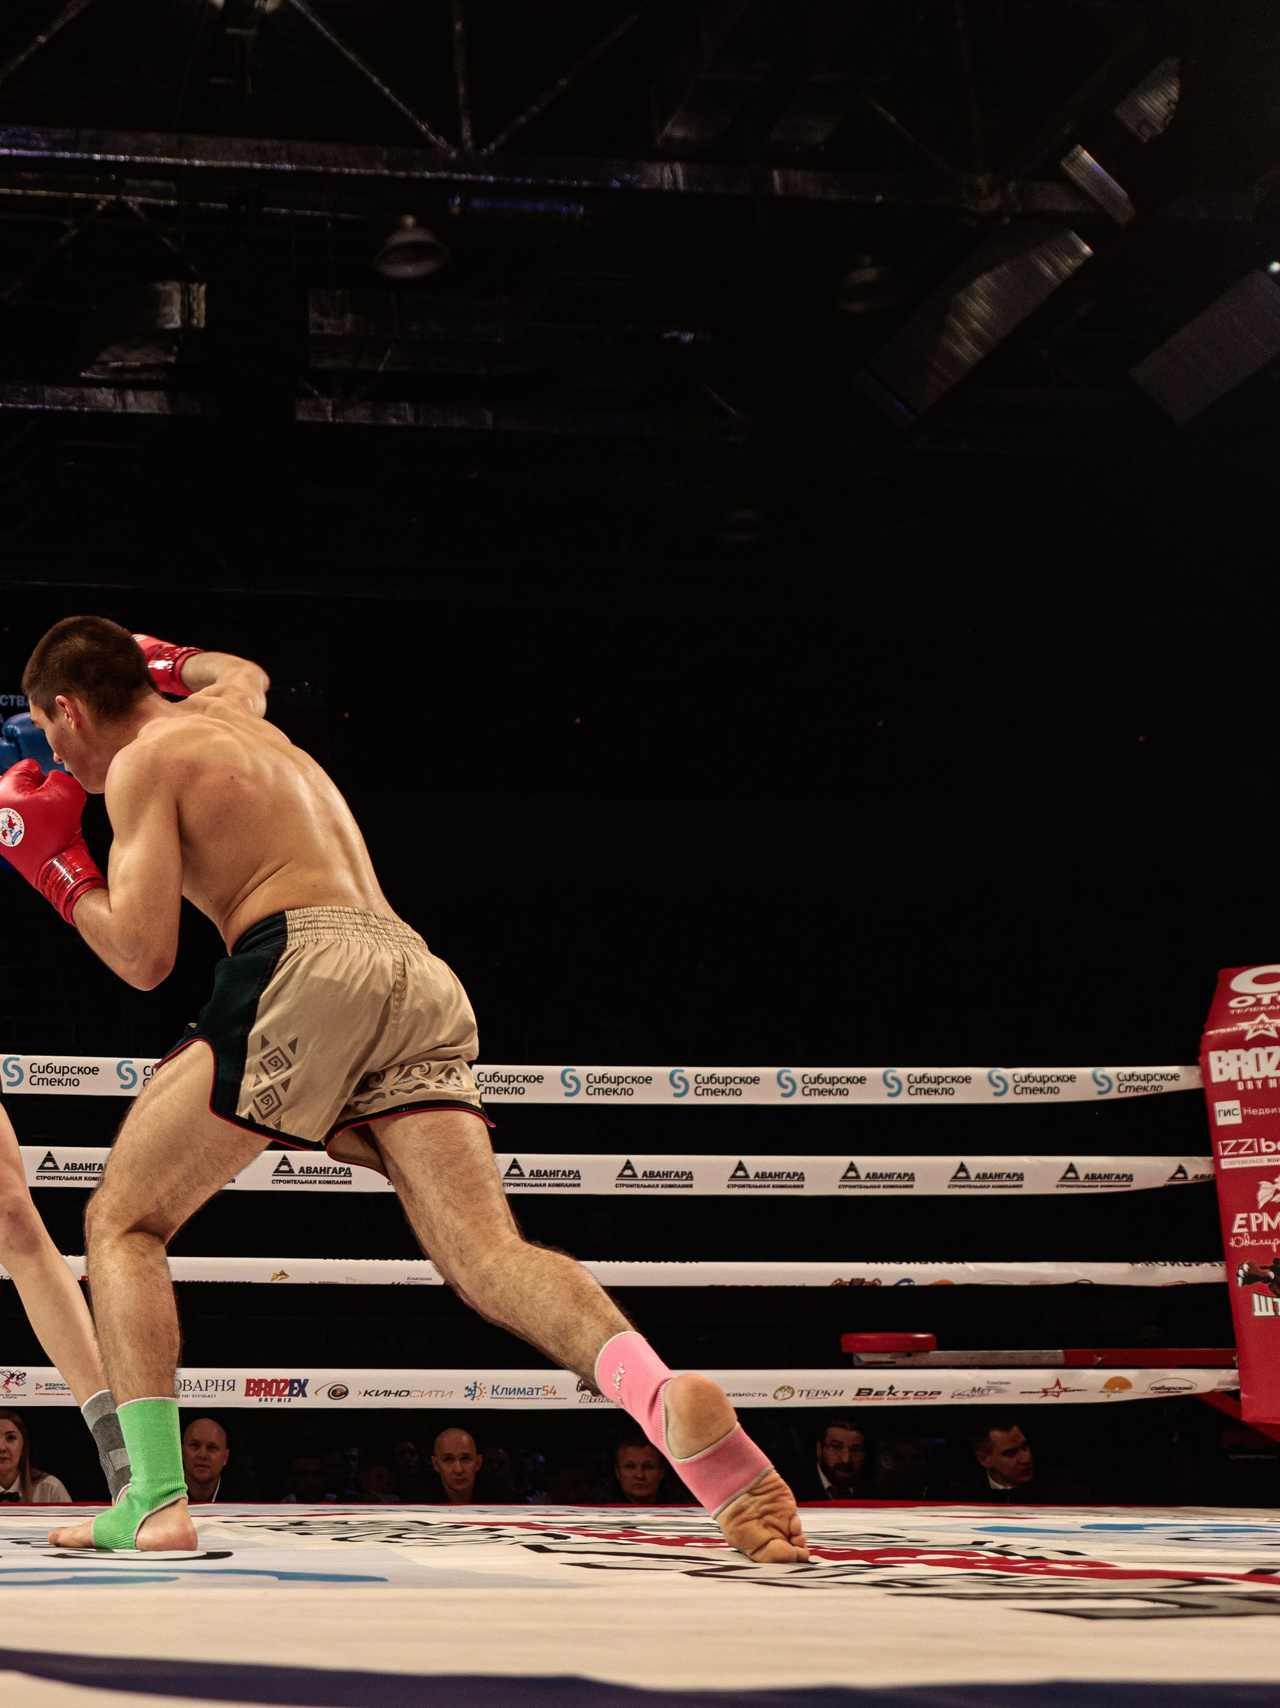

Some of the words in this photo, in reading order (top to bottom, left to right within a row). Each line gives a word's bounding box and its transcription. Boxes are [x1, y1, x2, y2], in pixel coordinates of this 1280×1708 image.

[29, 1062, 100, 1076] Сибирское
[1209, 1046, 1280, 1083] BROZ
[29, 1075, 80, 1087] Стекло
[477, 1072, 544, 1084] Сибирское
[586, 1073, 653, 1085] Сибирское
[694, 1074, 760, 1086] Сибирское
[801, 1074, 867, 1086] Сибирское
[907, 1073, 972, 1085] Сибирское
[1013, 1073, 1077, 1084] Сибирское
[1116, 1071, 1180, 1083] Сибирское
[478, 1084, 525, 1095] Стекло
[586, 1085, 634, 1096] Стекло
[801, 1085, 849, 1097] Стекло
[907, 1085, 955, 1096] Стекло
[1014, 1084, 1060, 1095] Стекло
[1117, 1082, 1163, 1093] Стекло
[1237, 1079, 1263, 1091] DRY
[694, 1086, 742, 1097] Стекло
[1217, 1107, 1240, 1119] ГИС
[63, 1162, 104, 1171] АВАНГА
[298, 1166, 352, 1176] АВАНГАРД
[528, 1169, 581, 1180] АВАНГАРД
[642, 1170, 694, 1180] АВАНГАРД
[754, 1171, 805, 1181] АВАНГАРД
[865, 1172, 915, 1181] АВАНГАРД
[975, 1172, 1024, 1181] АВАНГАРД
[1084, 1172, 1133, 1182] АВАНГАРД
[1232, 1211, 1280, 1233] ЕРМ
[1230, 1233, 1280, 1252] Ювелир
[1252, 1292, 1280, 1317] ШТ
[244, 1378, 309, 1398] BROZEX
[363, 1389, 454, 1398] КИНОСИТИ
[491, 1384, 557, 1396] Климат54
